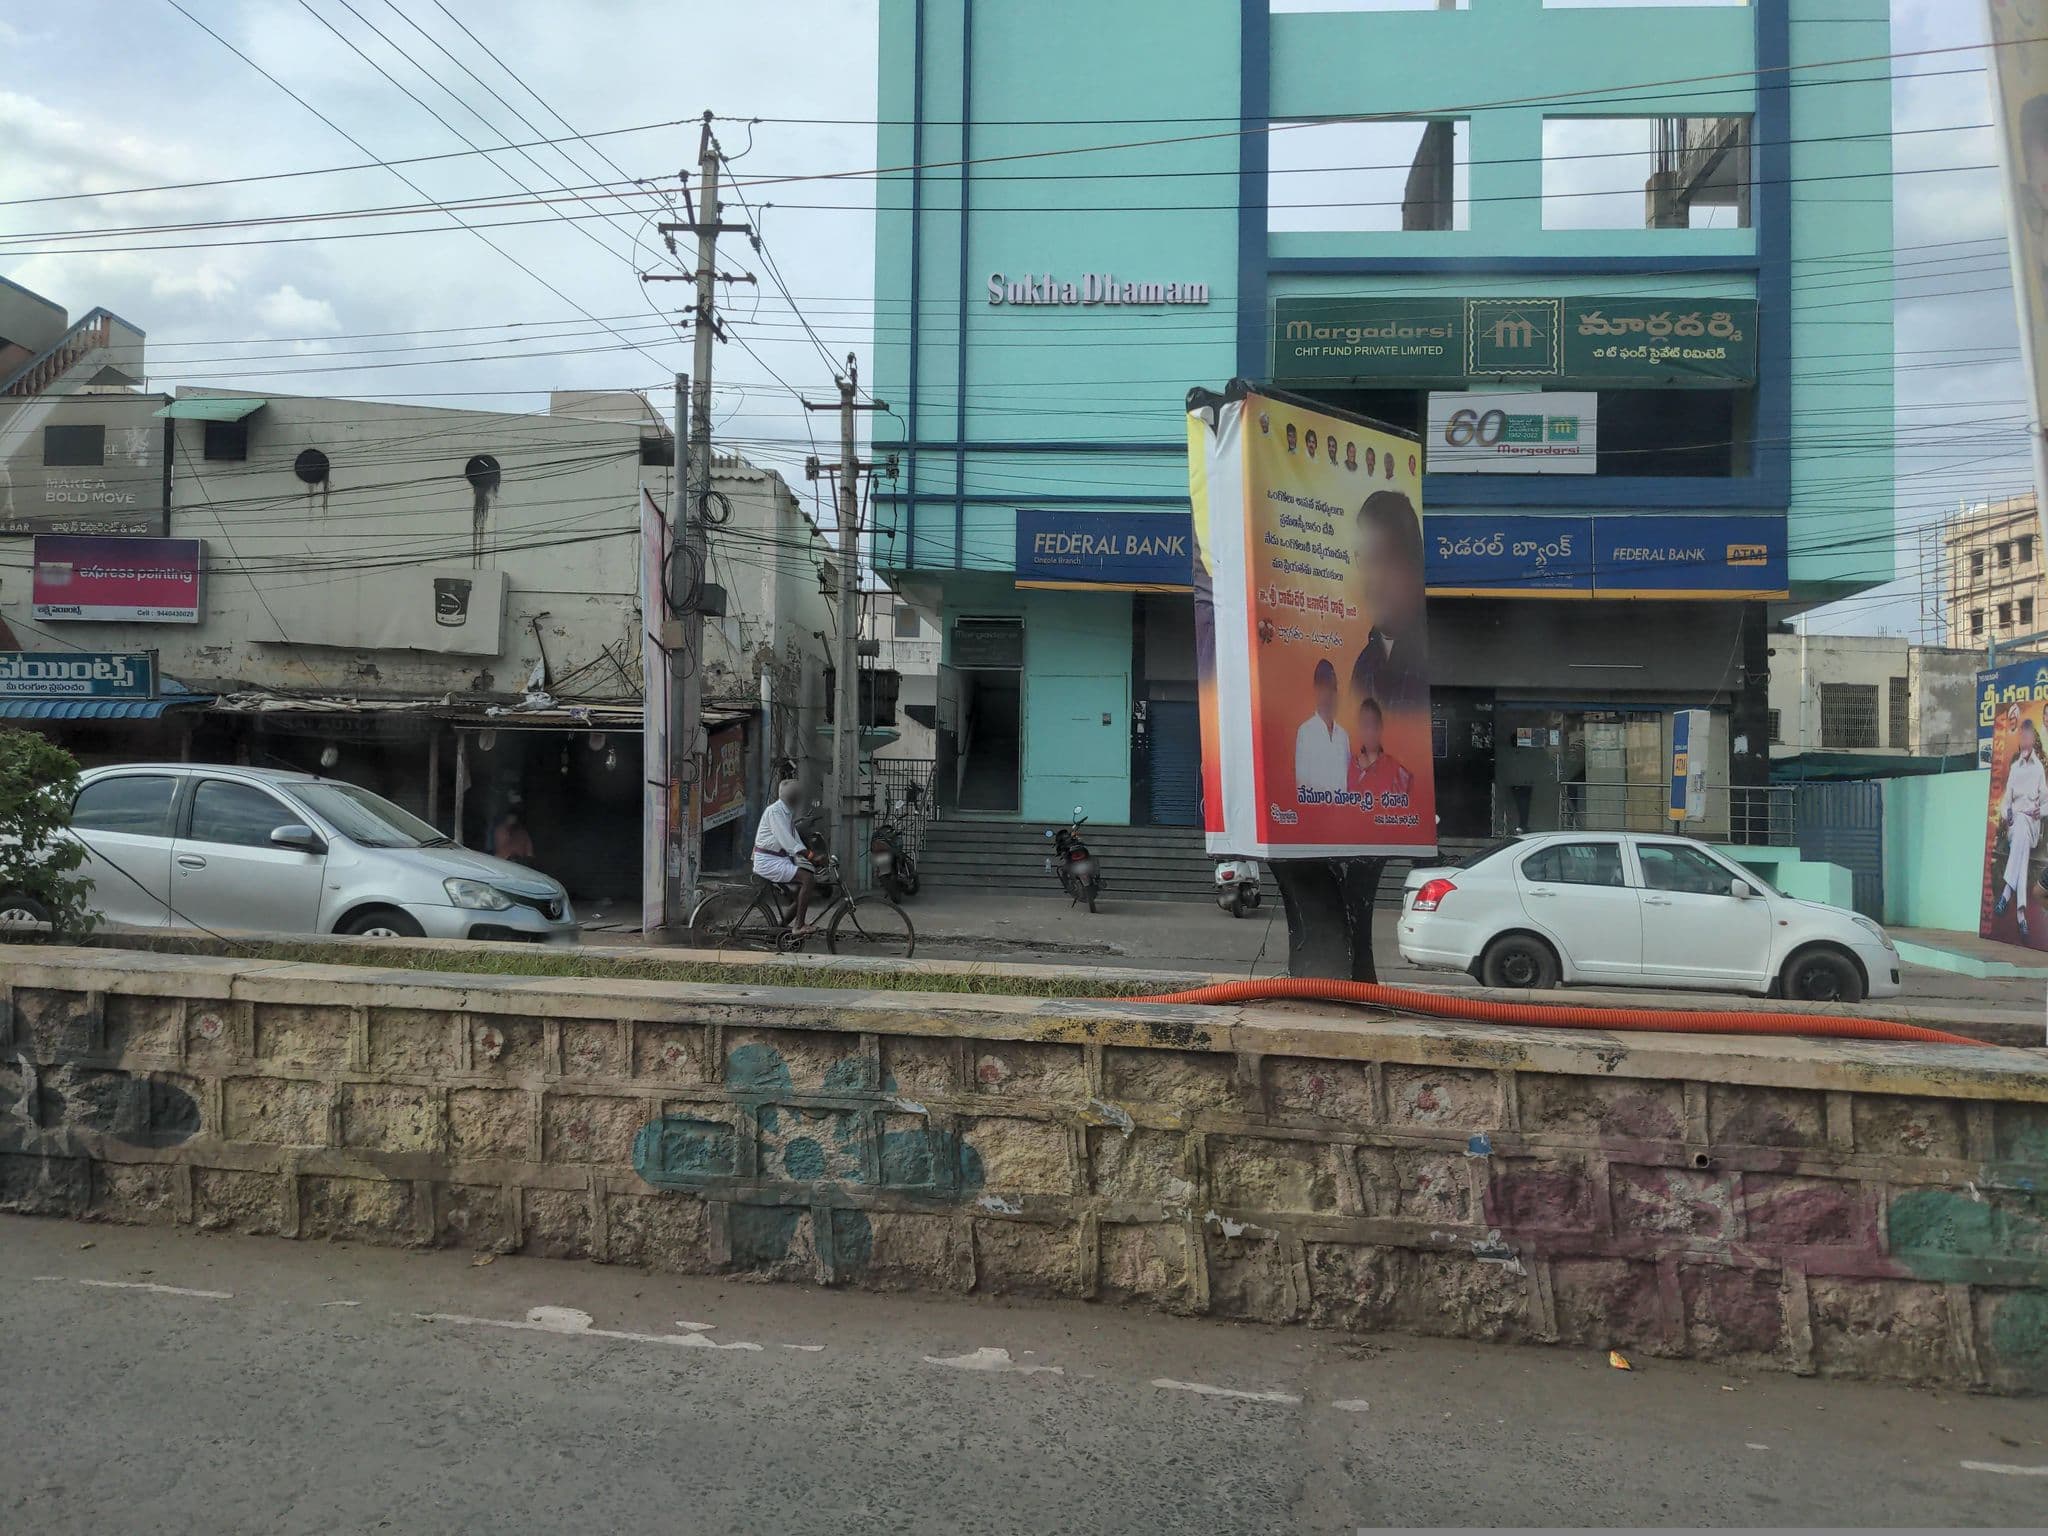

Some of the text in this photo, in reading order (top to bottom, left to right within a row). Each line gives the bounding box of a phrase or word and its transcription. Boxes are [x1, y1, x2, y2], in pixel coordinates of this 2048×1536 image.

[987, 272, 1210, 305] Sukha Dhamam
[1286, 320, 1453, 344] Margadarsi
[1295, 346, 1443, 356] CHIT FUND PRIVATE LIMITED
[1446, 409, 1506, 447] 60
[1497, 444, 1580, 455] Margadarsi
[46, 479, 106, 489] MAKE A
[46, 492, 136, 504] BOLD MOVE
[10, 523, 30, 531] BAR
[1034, 533, 1186, 557] FEDERAL BANK
[1437, 533, 1573, 566] ఫెడరల్ బ్యాంక్
[1613, 548, 1706, 561] FEDERAL BANK
[79, 565, 193, 583] express painting
